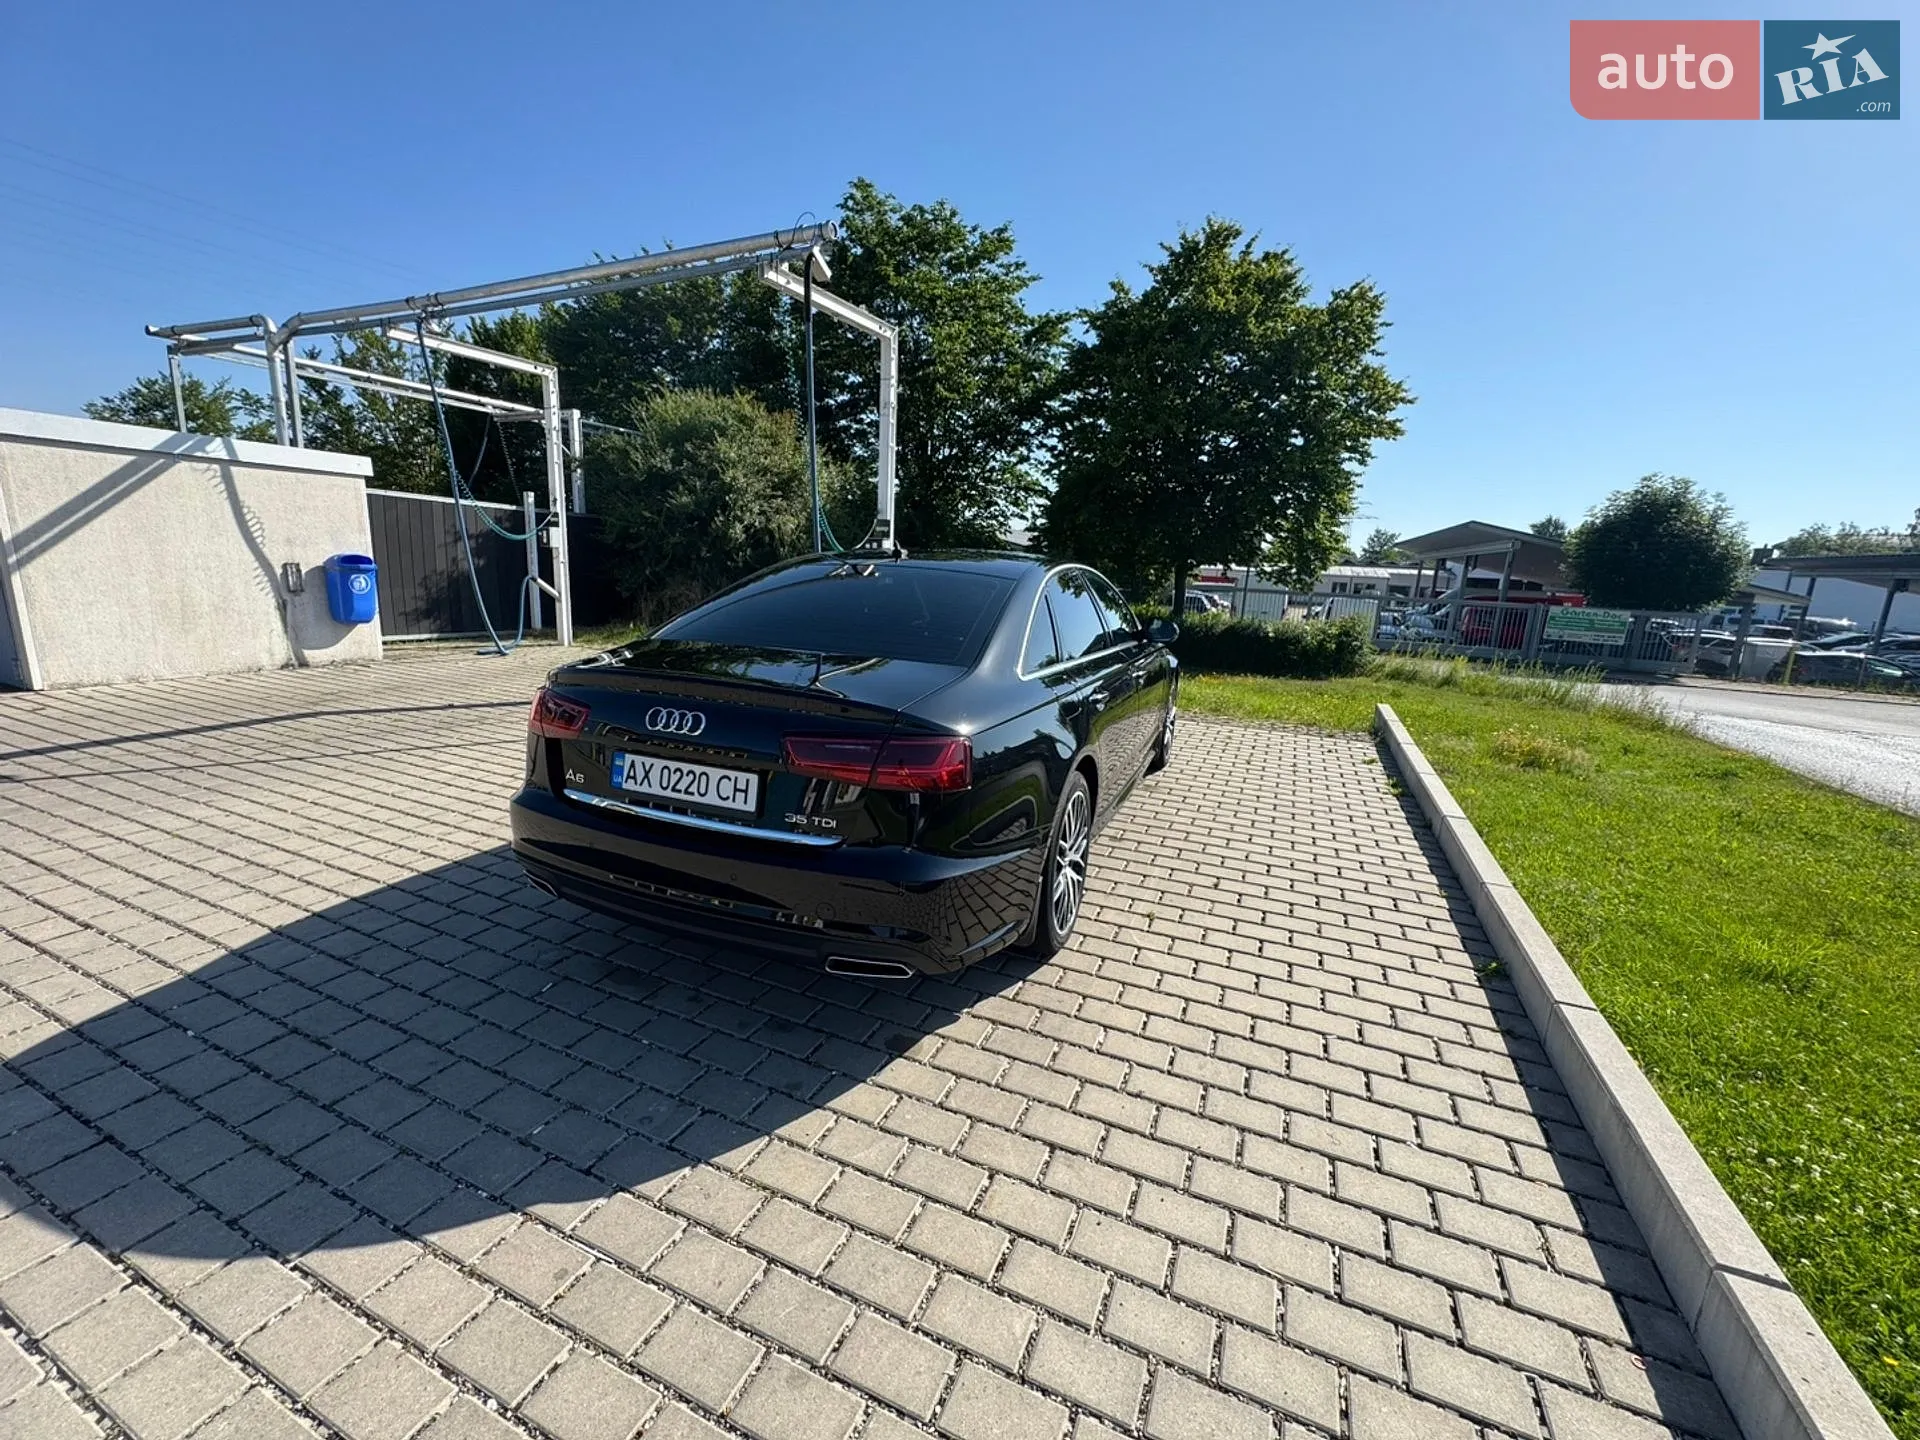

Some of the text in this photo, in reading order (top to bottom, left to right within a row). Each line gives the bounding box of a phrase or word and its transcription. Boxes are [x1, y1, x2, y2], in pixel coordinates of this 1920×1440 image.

[565, 769, 585, 784] A6
[624, 759, 750, 805] AX 0220 CH
[784, 812, 837, 829] 35 TDI
